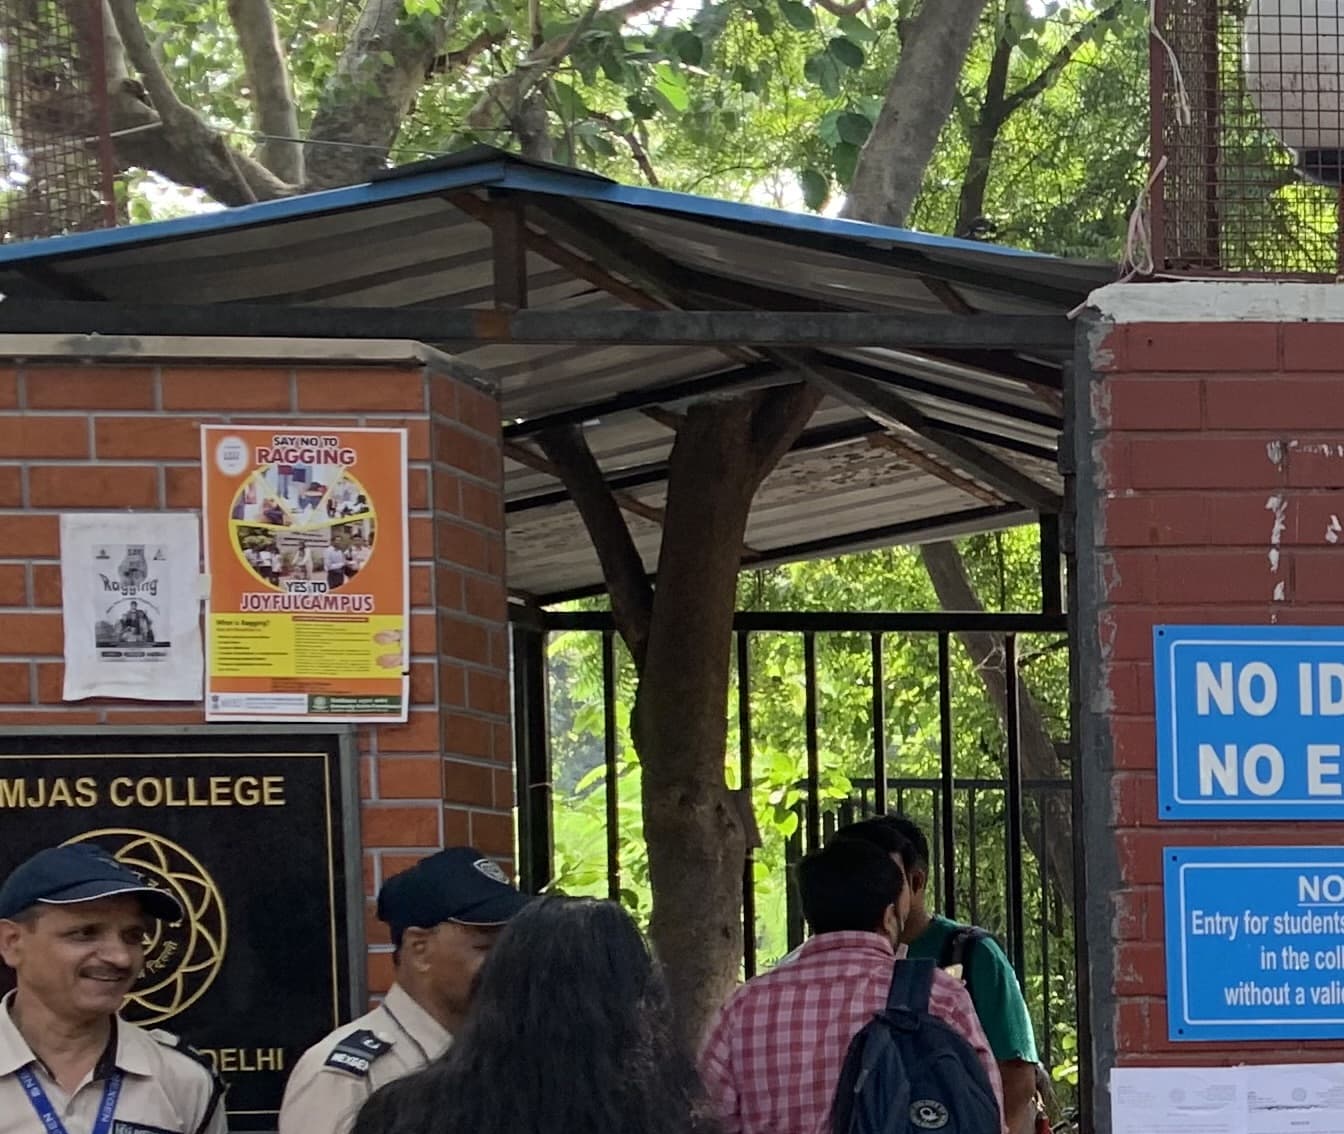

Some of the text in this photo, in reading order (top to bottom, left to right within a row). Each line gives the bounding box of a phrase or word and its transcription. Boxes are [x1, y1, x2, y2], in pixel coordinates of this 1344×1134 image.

[274, 437, 338, 447] SAY NO TO
[257, 449, 355, 465] RAGGING
[286, 582, 327, 593] YES TO
[1197, 661, 1277, 716] NO
[1199, 743, 1284, 796] NO
[0, 776, 287, 808] MJAS COLLEGE
[1192, 910, 1239, 941] Entry
[1244, 910, 1269, 934] for
[1261, 946, 1277, 969] in
[1282, 946, 1310, 970] the
[1225, 981, 1291, 1006] without
[1295, 987, 1306, 1005] a
